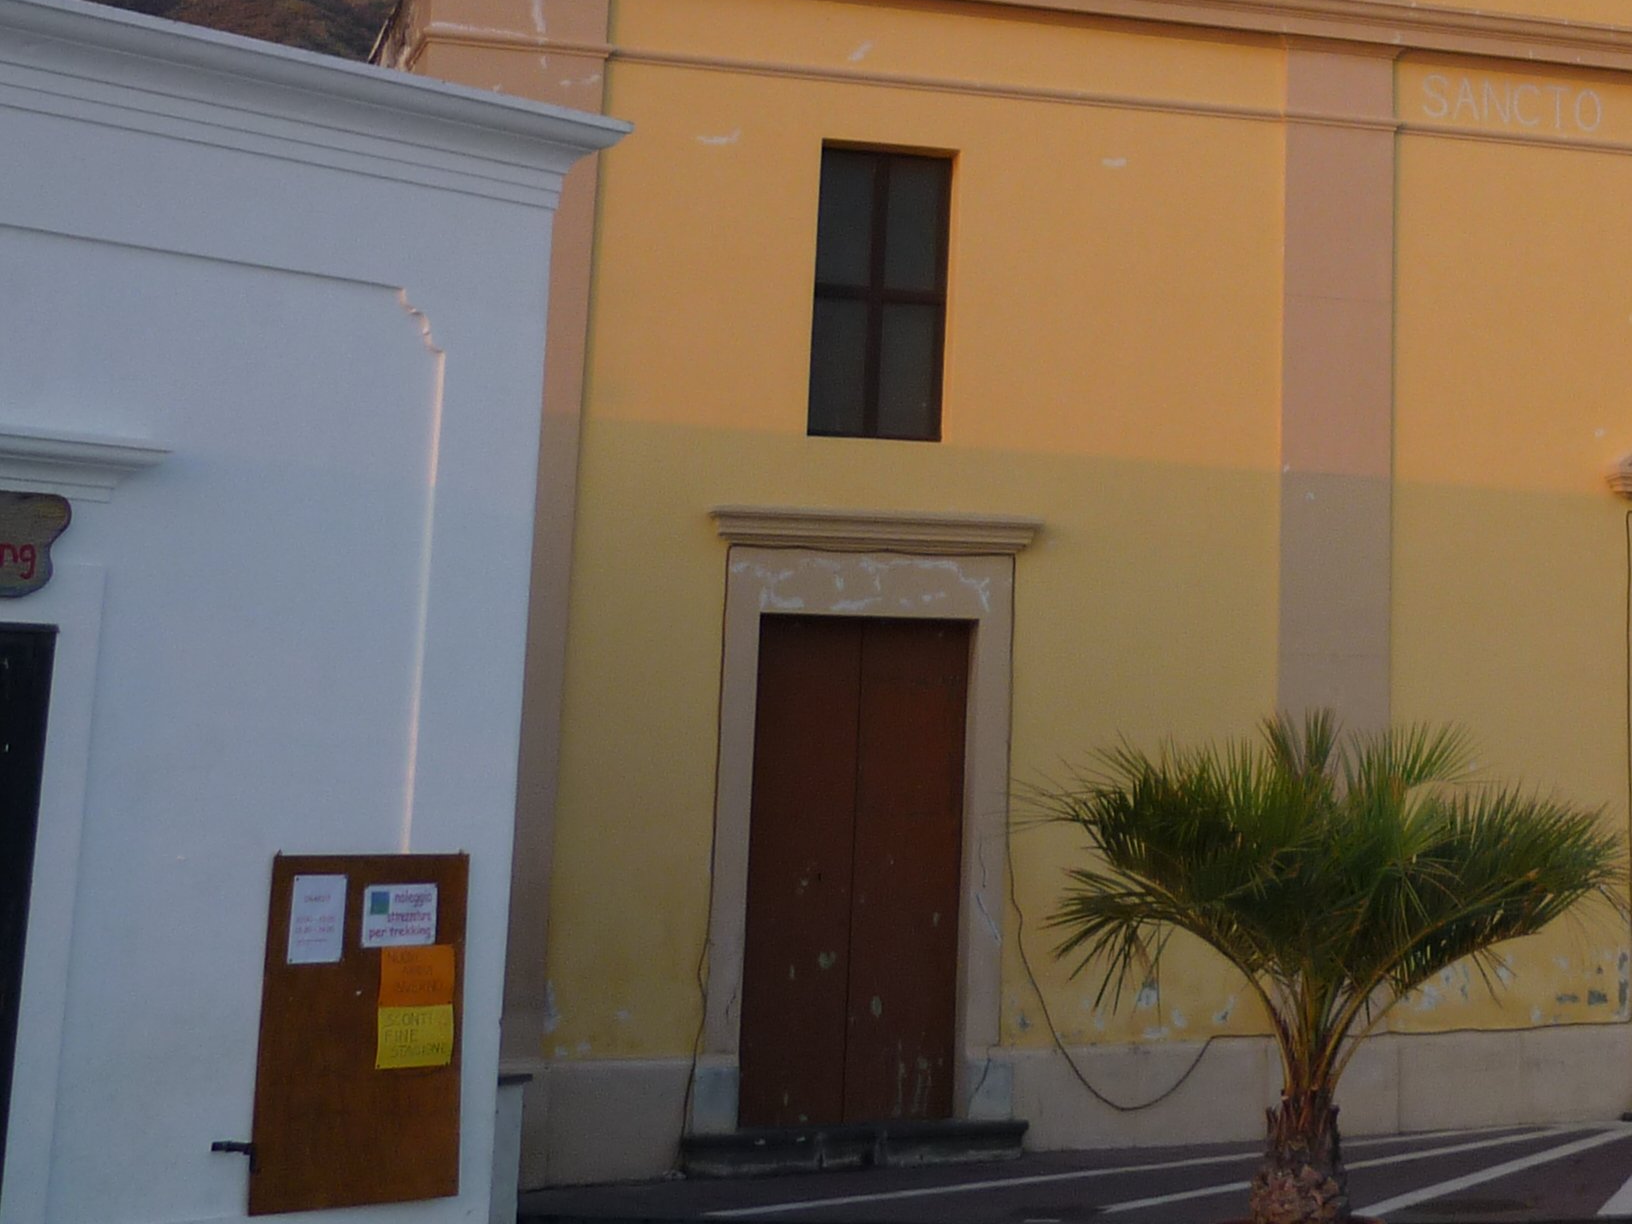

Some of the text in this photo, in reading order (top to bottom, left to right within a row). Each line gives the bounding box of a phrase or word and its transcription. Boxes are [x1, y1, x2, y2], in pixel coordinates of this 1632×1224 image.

[1422, 73, 1605, 133] SANCTO
[368, 925, 432, 941] per trekking
